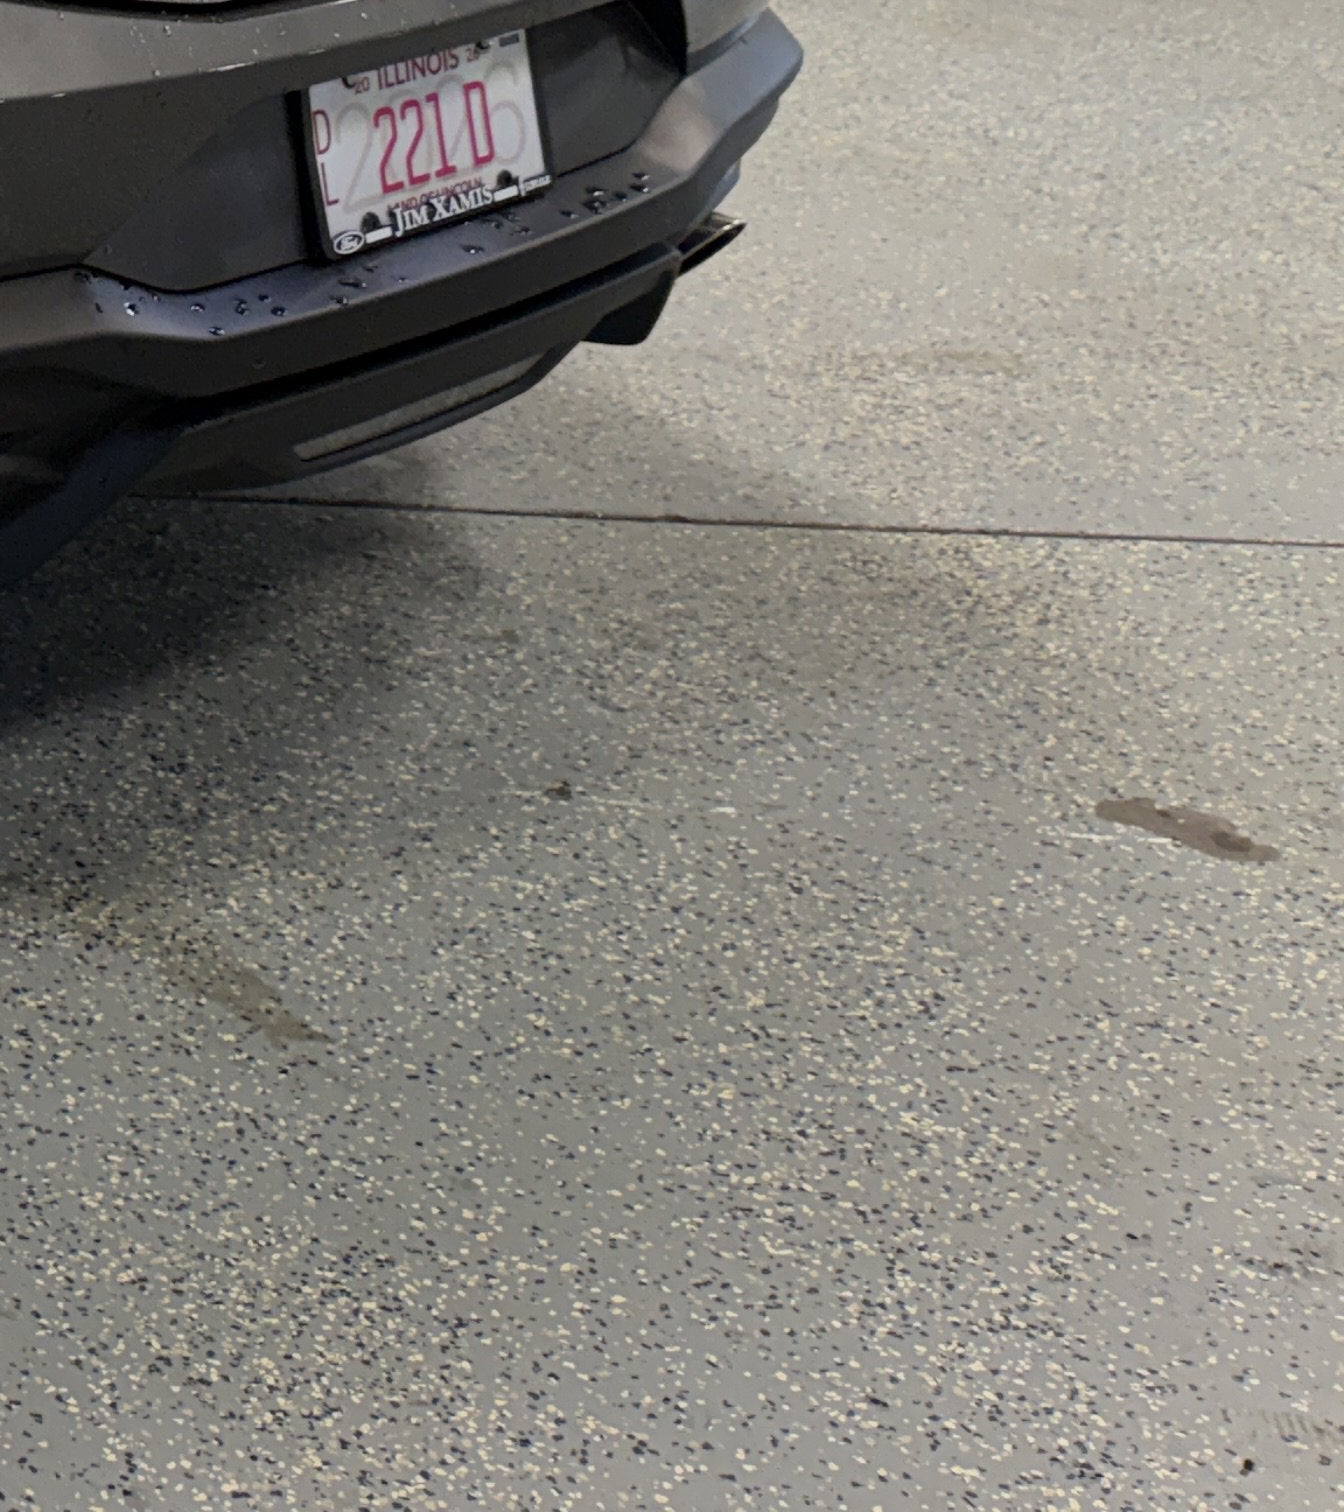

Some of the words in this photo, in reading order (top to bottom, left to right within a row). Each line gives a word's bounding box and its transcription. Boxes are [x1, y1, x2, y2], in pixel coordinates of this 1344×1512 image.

[376, 48, 460, 90] ILLINOIS
[392, 205, 431, 237] JIM
[429, 187, 494, 222] XAMIS
